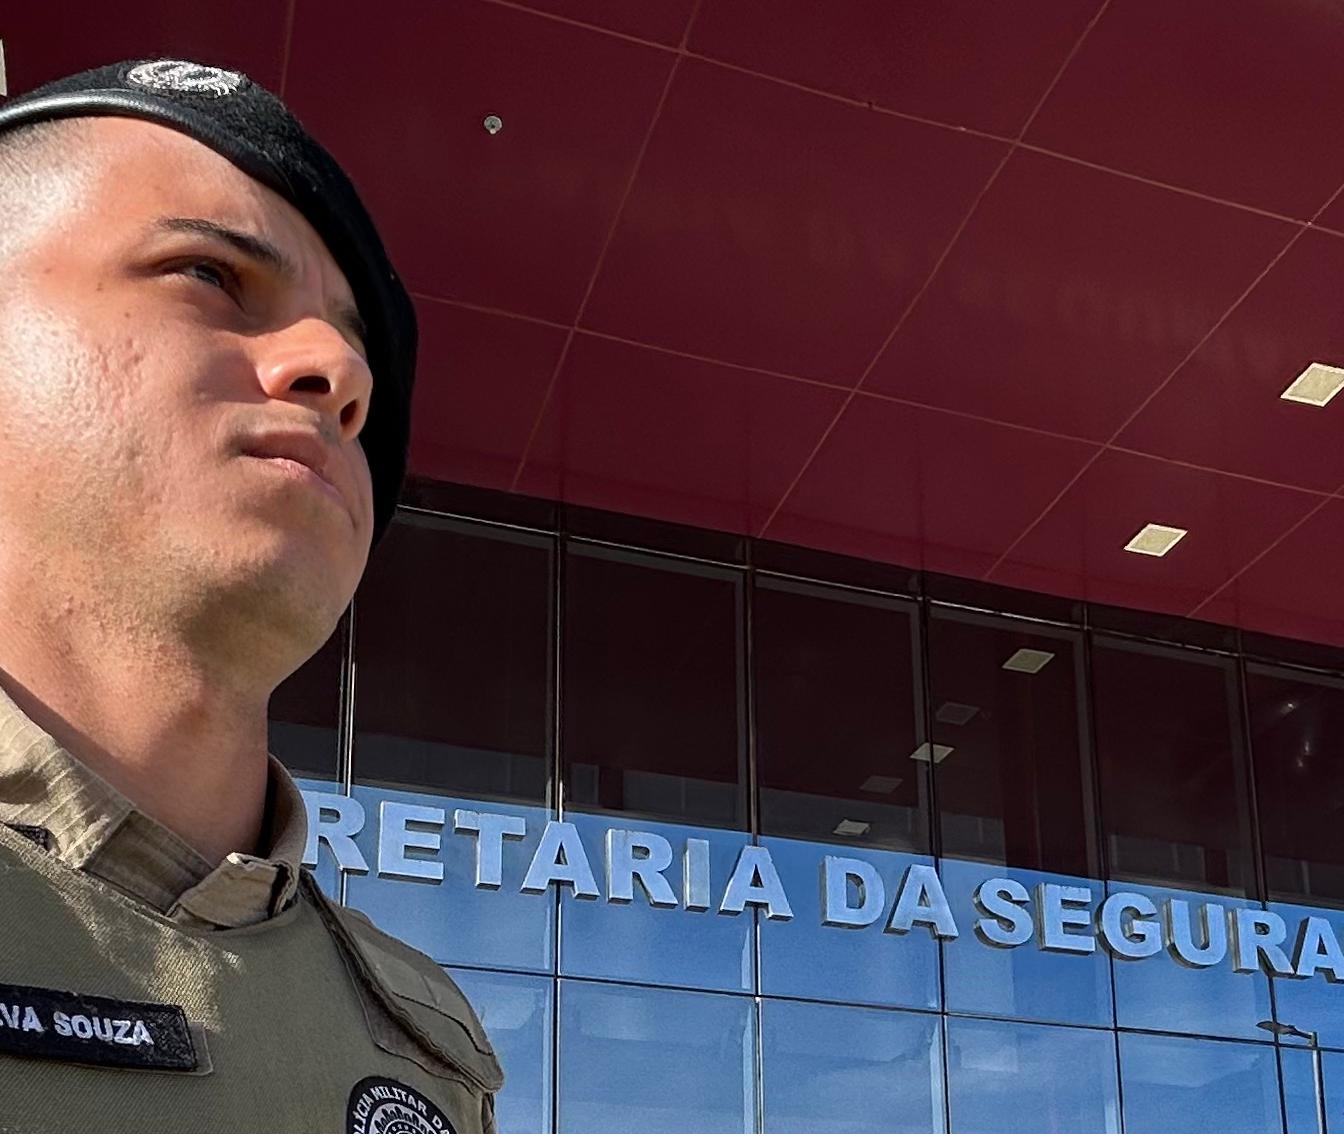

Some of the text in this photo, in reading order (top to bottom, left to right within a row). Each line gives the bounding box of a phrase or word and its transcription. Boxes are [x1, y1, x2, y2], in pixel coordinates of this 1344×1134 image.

[300, 789, 794, 922] RETARIA
[820, 855, 959, 941] DA
[54, 1011, 155, 1046] SOUZA
[369, 1086, 427, 1117] MILITAR
